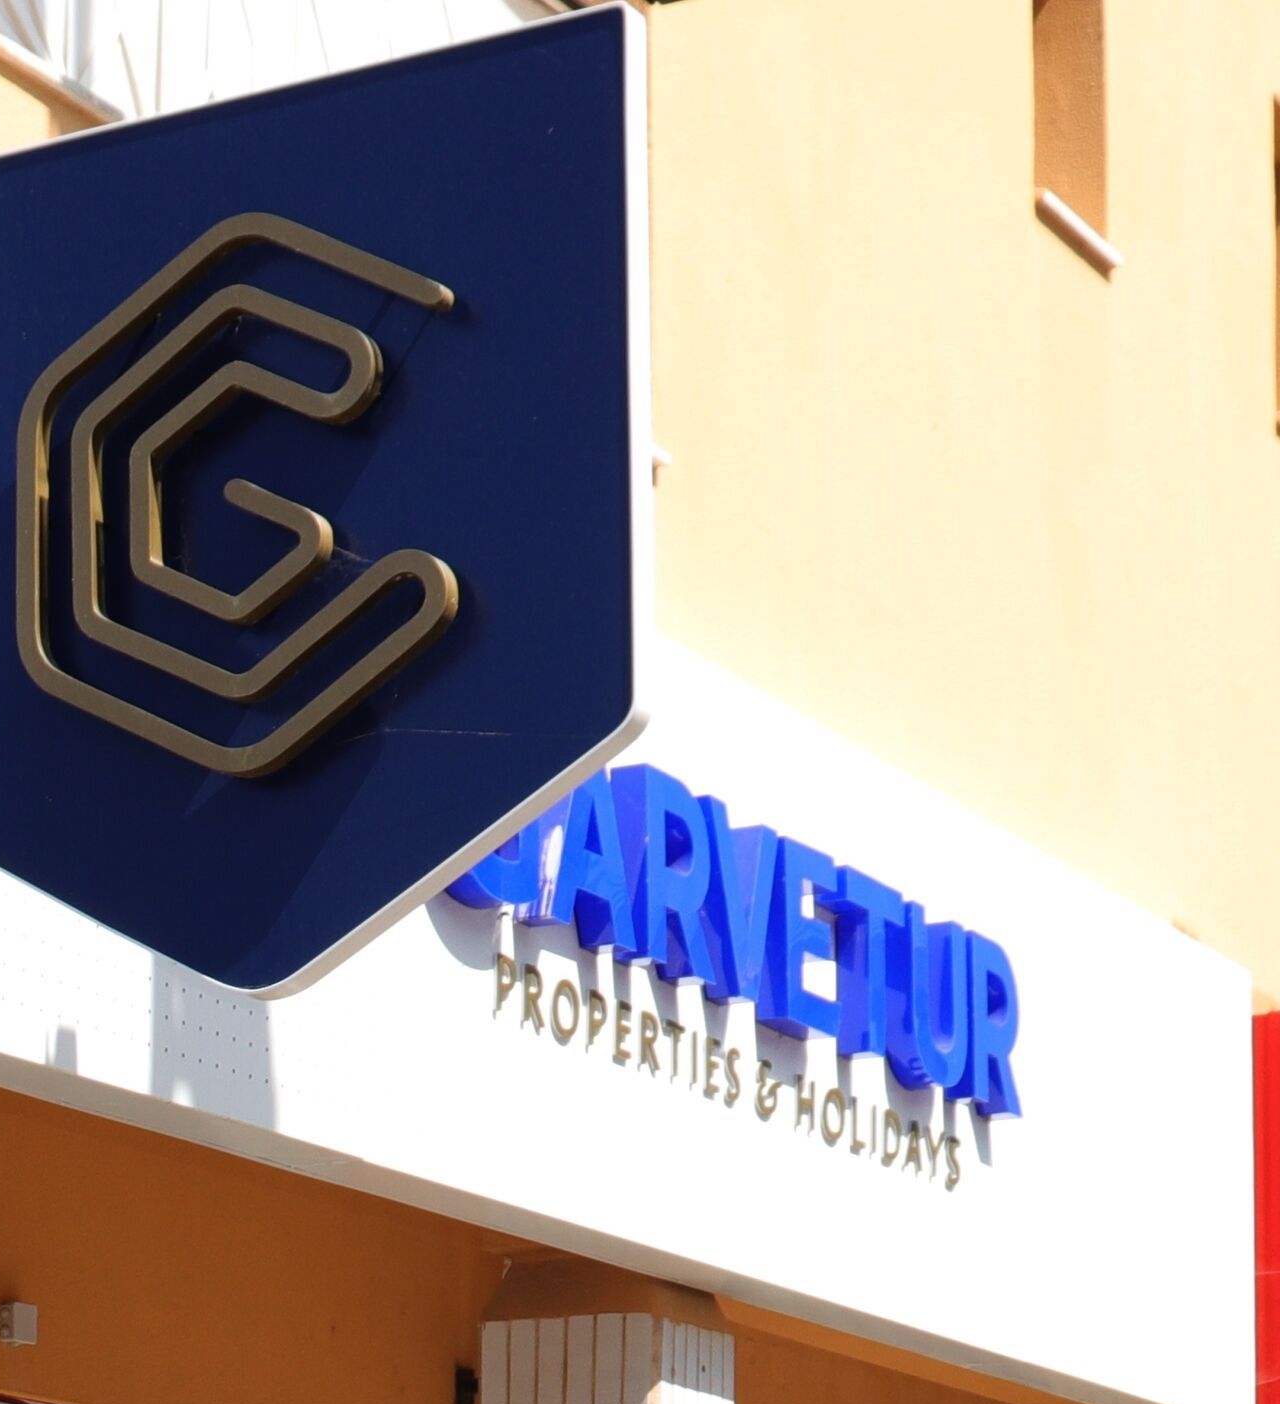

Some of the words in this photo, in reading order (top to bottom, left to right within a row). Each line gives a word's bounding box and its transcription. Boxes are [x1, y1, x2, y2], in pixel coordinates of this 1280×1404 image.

[443, 762, 1023, 1118] ARVETUR
[493, 952, 741, 1107] PROPERTIES
[755, 1058, 782, 1119] &
[794, 1074, 962, 1191] HOLIDAYS
